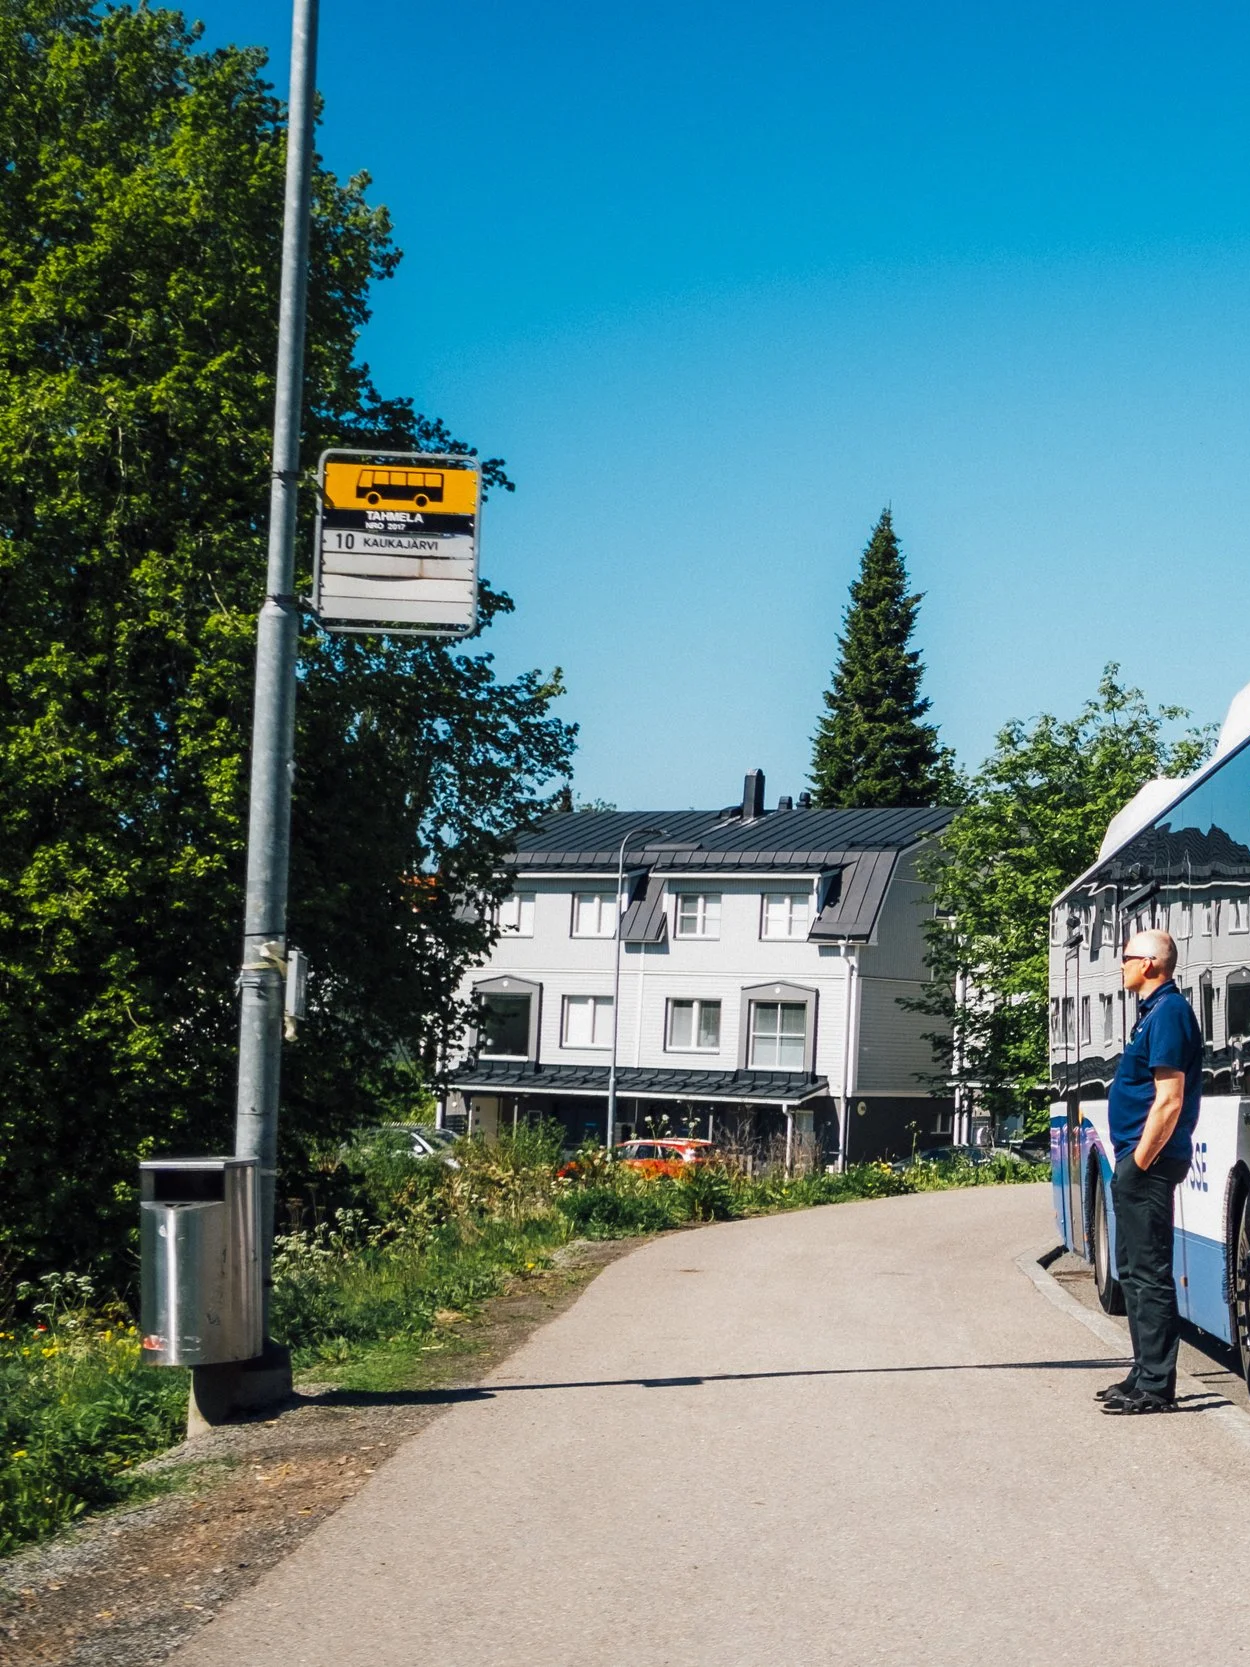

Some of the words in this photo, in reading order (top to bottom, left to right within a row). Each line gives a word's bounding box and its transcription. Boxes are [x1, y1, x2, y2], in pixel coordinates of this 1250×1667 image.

[366, 511, 424, 523] TAHMELA
[365, 522, 384, 530] NRO
[336, 532, 355, 550] 10
[363, 536, 439, 551] KAUKAJÄRVI
[1186, 1142, 1208, 1193] SSE
